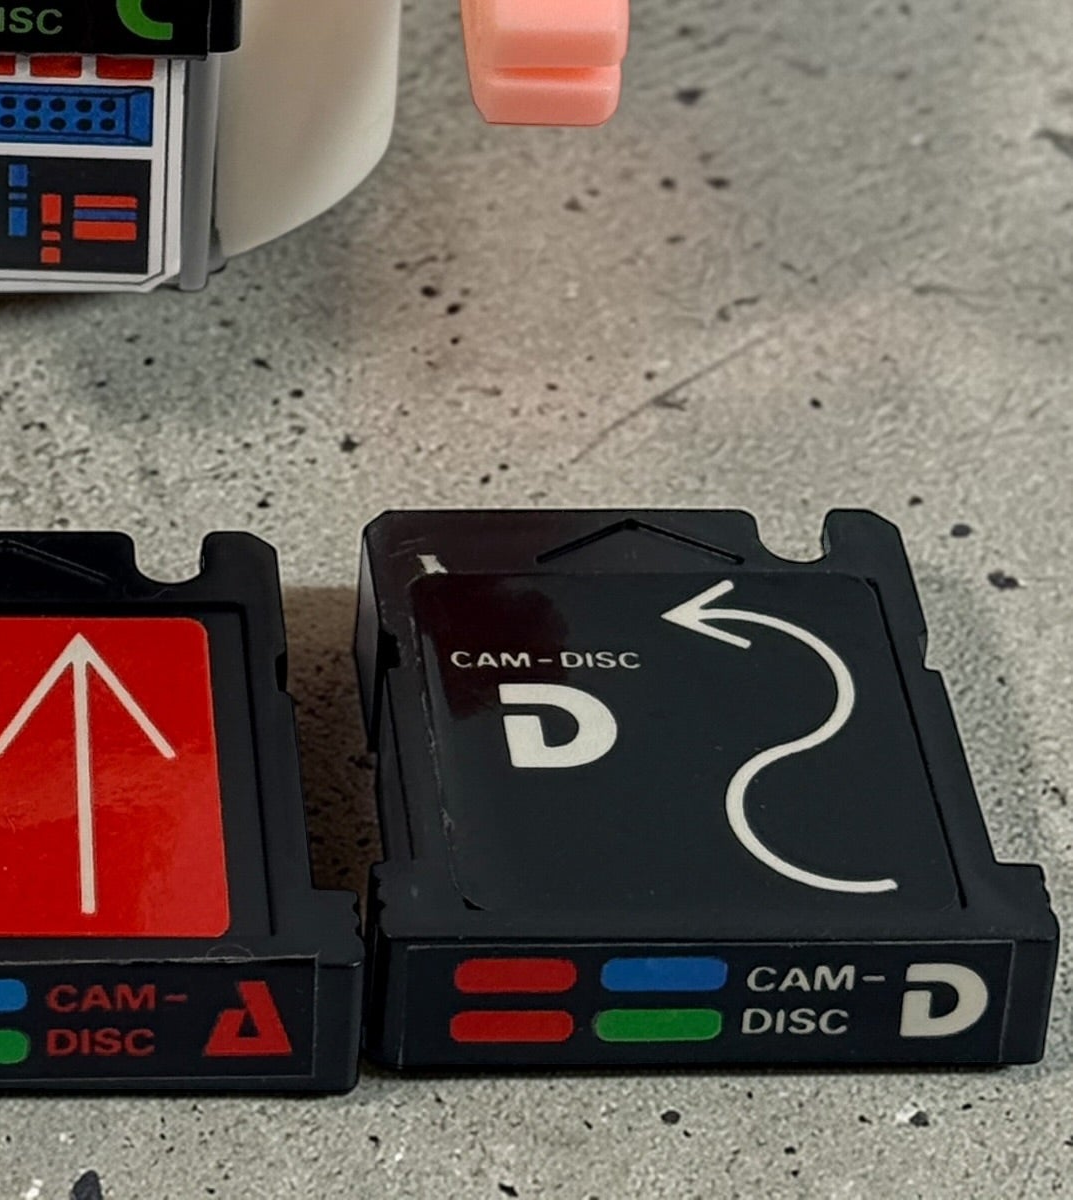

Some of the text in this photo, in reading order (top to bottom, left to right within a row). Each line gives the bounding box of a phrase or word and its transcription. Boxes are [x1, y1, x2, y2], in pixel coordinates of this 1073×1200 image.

[498, 683, 618, 768] D
[44, 980, 294, 1057] CAM- A
[740, 1008, 850, 1035] DISC
[745, 962, 989, 1038] CAM- D
[45, 1028, 156, 1058] DISC
